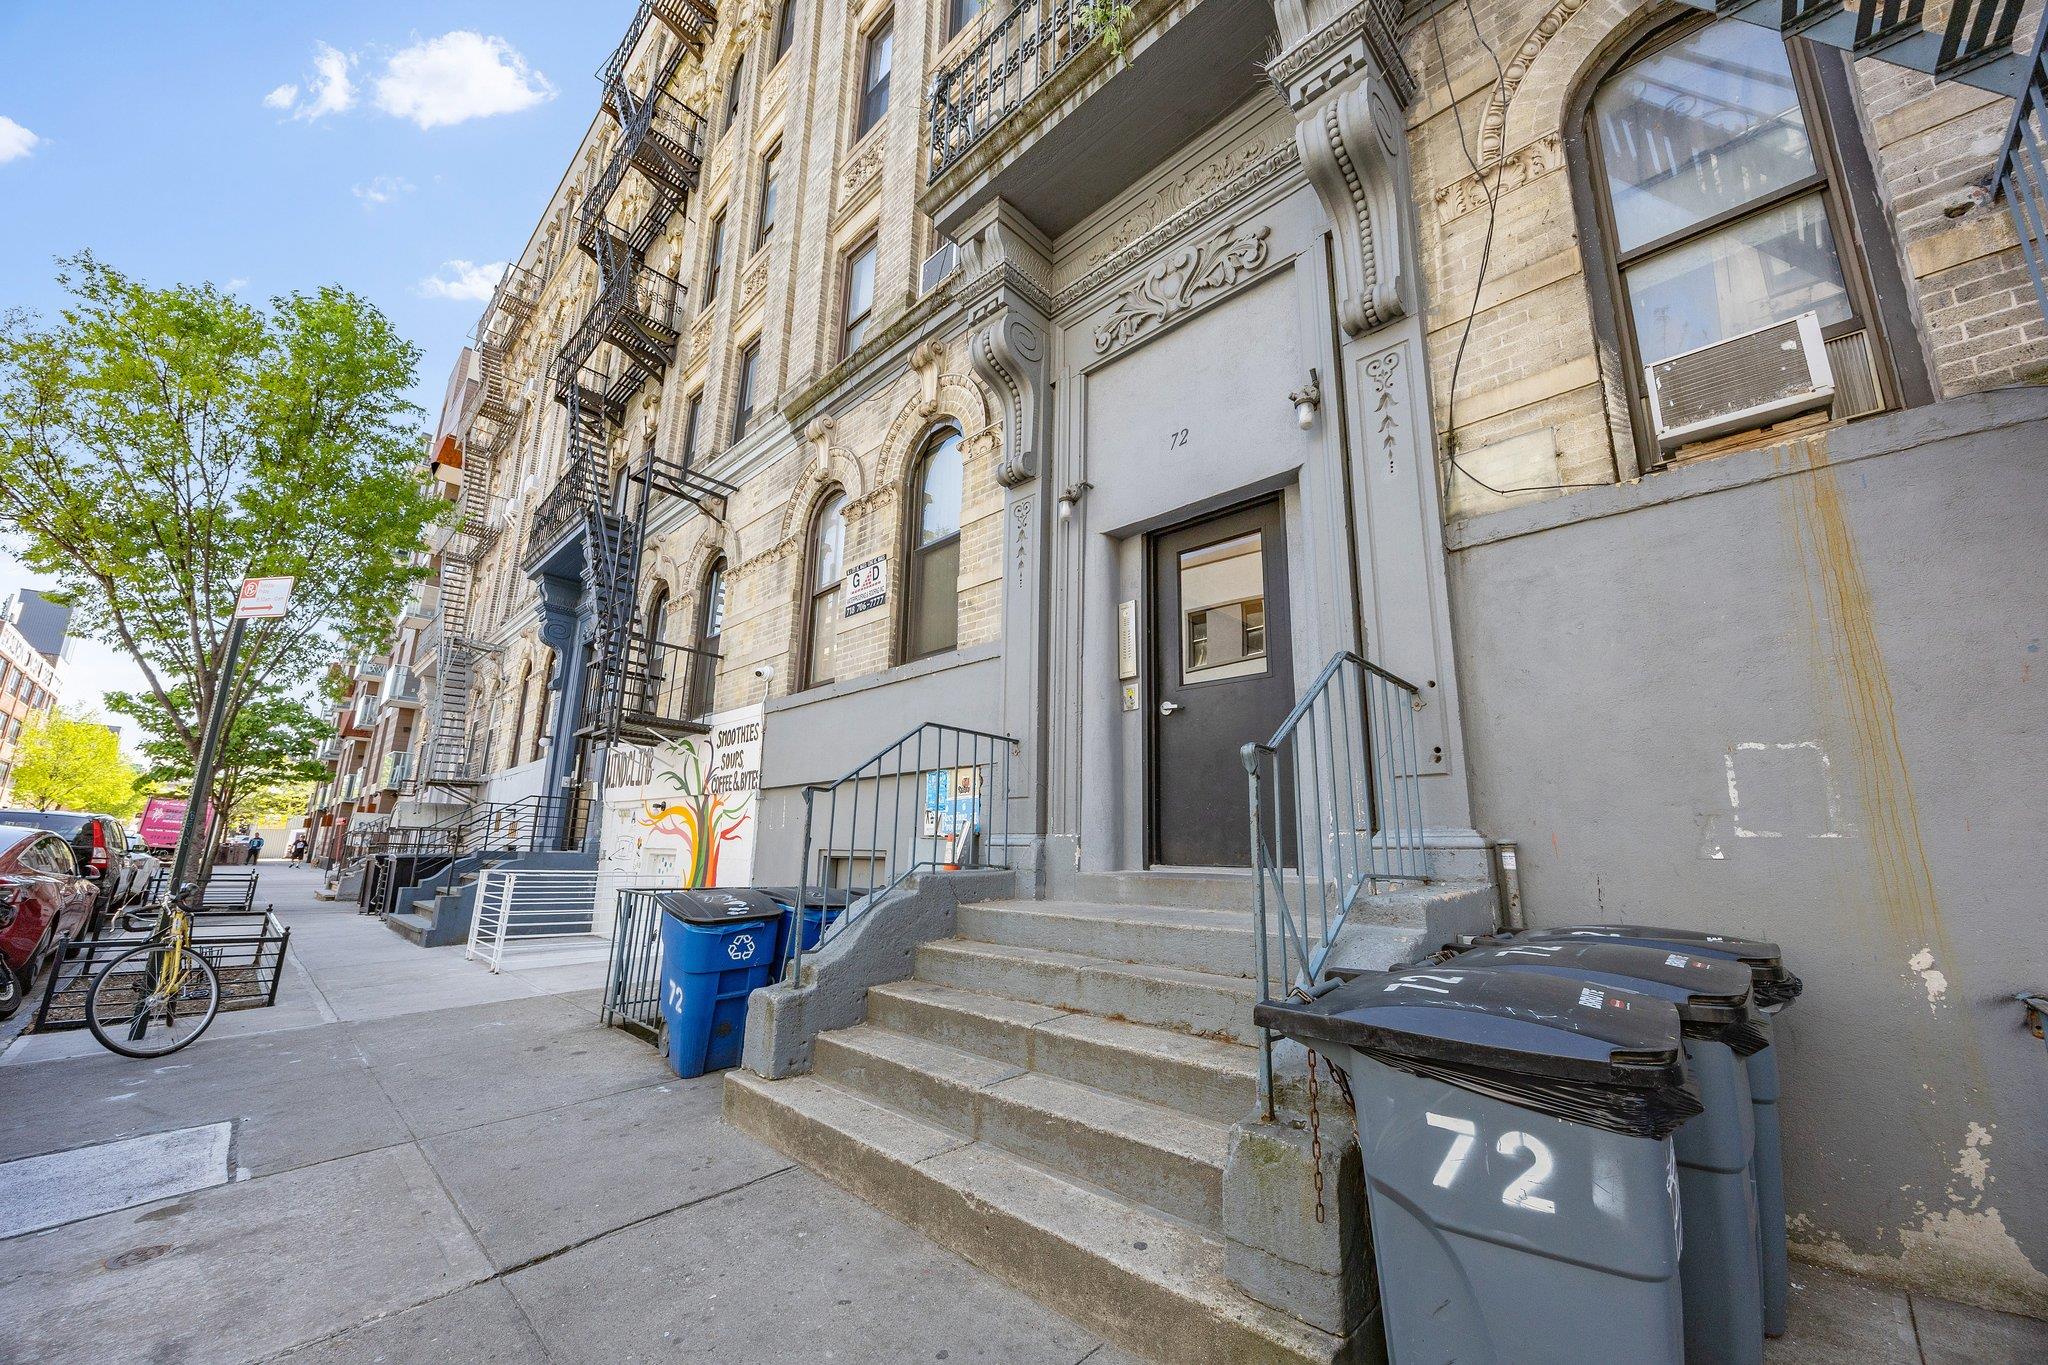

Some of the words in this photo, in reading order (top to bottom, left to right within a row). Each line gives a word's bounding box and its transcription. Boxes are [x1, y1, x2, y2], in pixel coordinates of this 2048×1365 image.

[1170, 428, 1189, 450] 72
[717, 723, 759, 749] SMOOTHIES
[711, 775, 732, 793] COFFEE
[733, 771, 739, 791] &
[669, 979, 683, 1014] 72
[1425, 1111, 1556, 1214] 72
